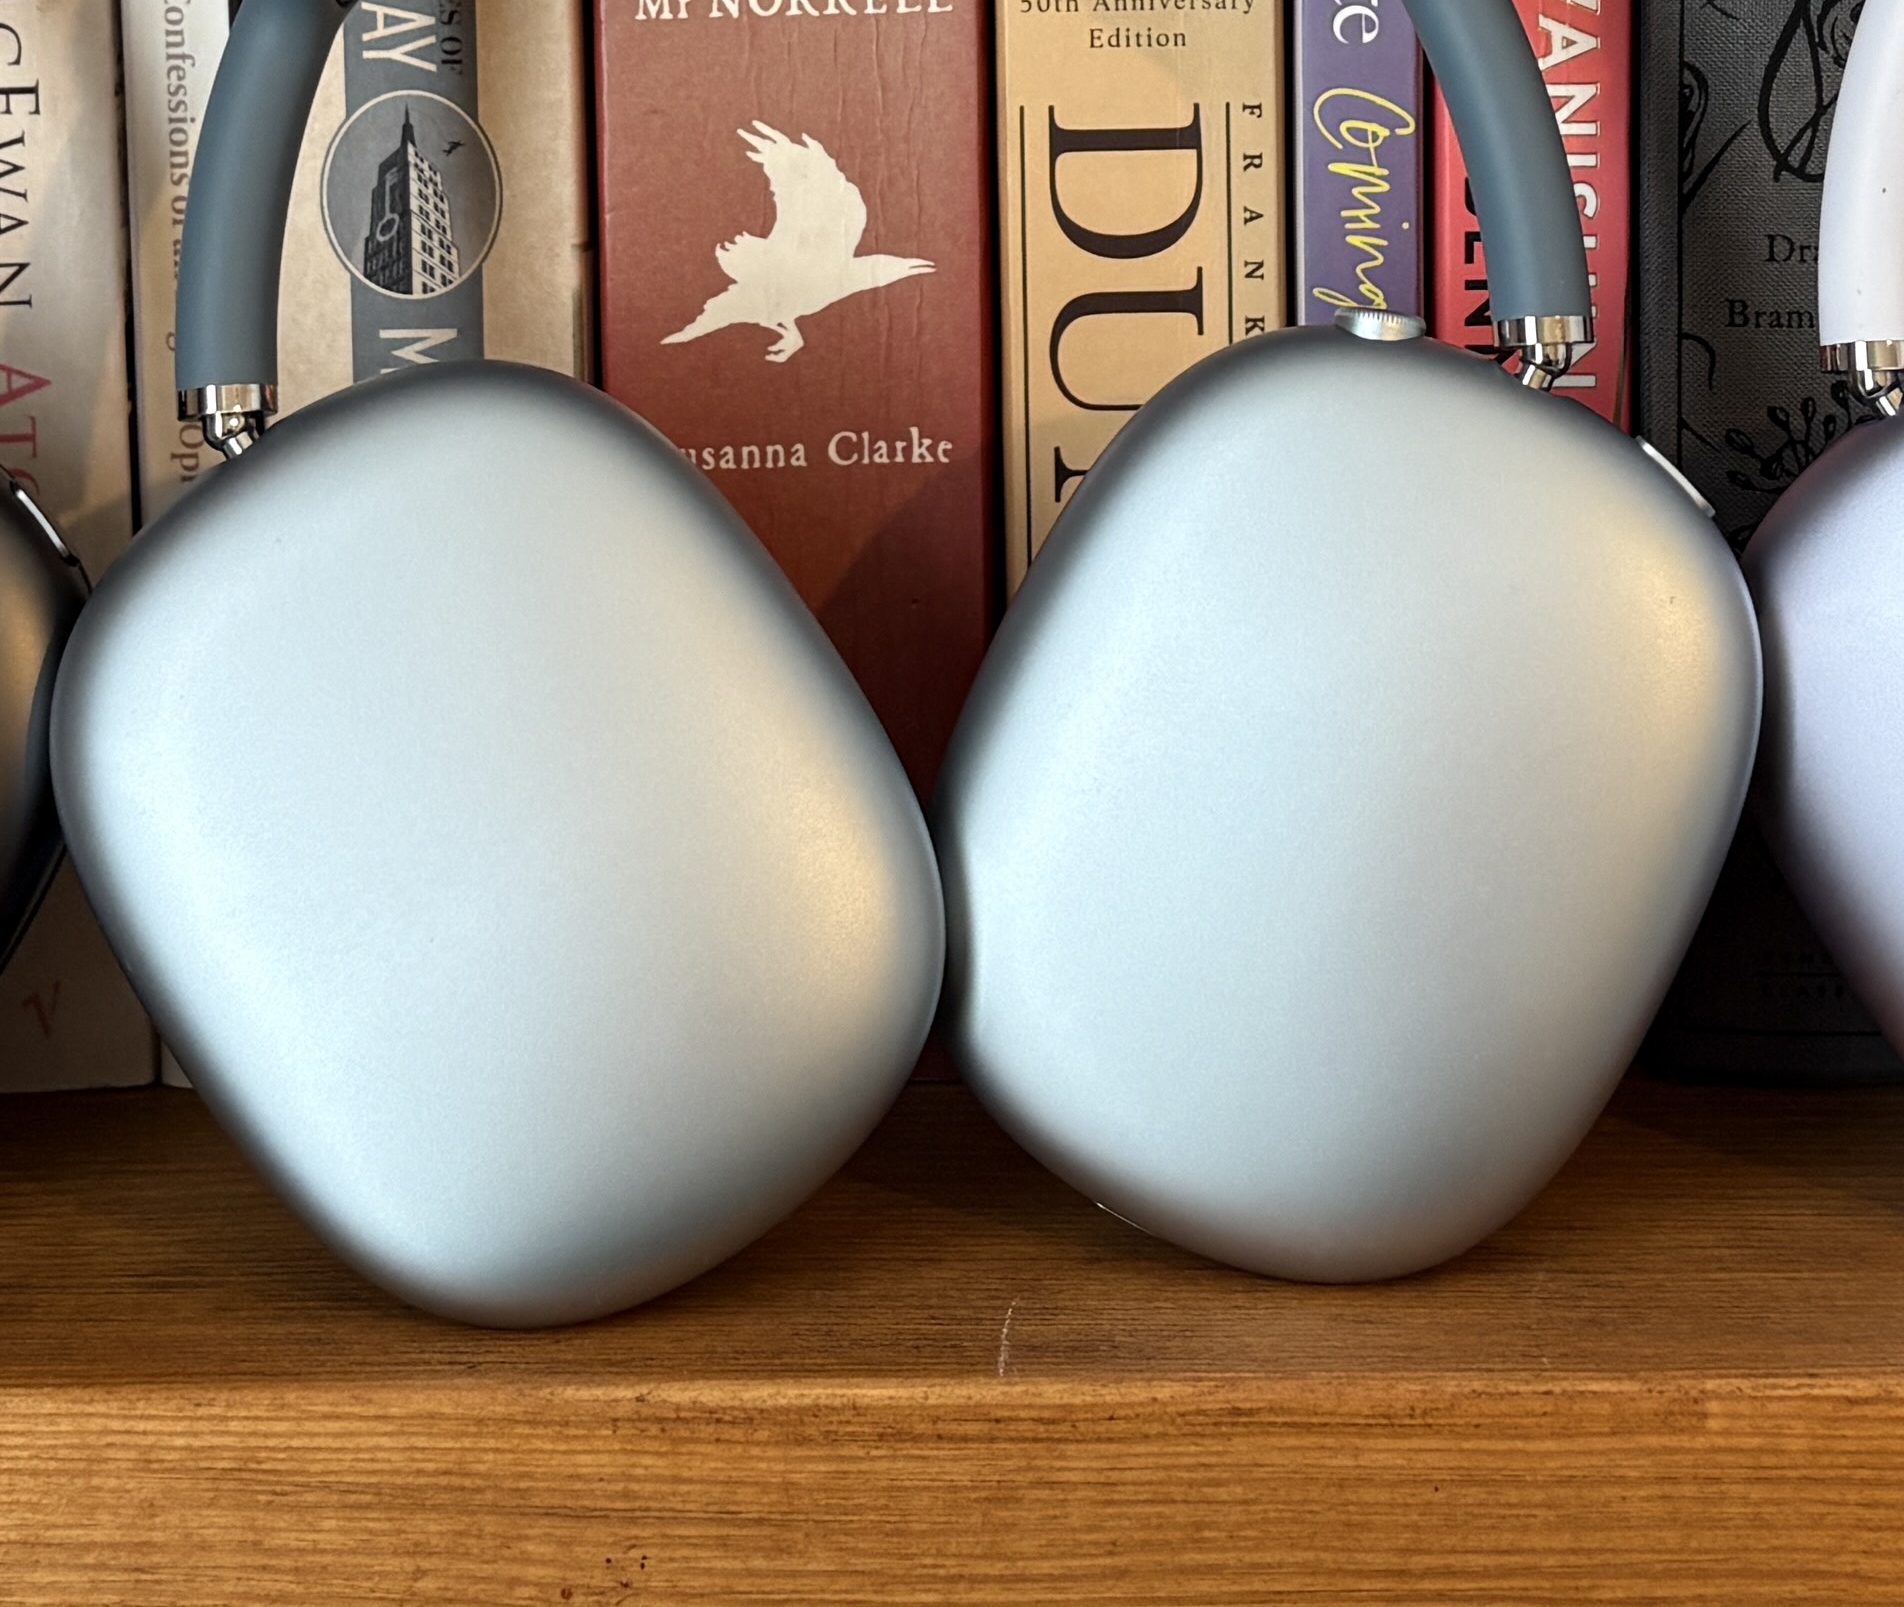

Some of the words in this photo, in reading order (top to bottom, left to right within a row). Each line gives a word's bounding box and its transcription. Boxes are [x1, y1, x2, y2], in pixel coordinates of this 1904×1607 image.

[1088, 28, 1188, 50] Edition
[1241, 102, 1267, 337] FRANK
[1047, 102, 1205, 504] DU
[1725, 297, 1816, 330] Bram
[678, 441, 808, 470] usanna
[827, 425, 954, 466] Clarke
